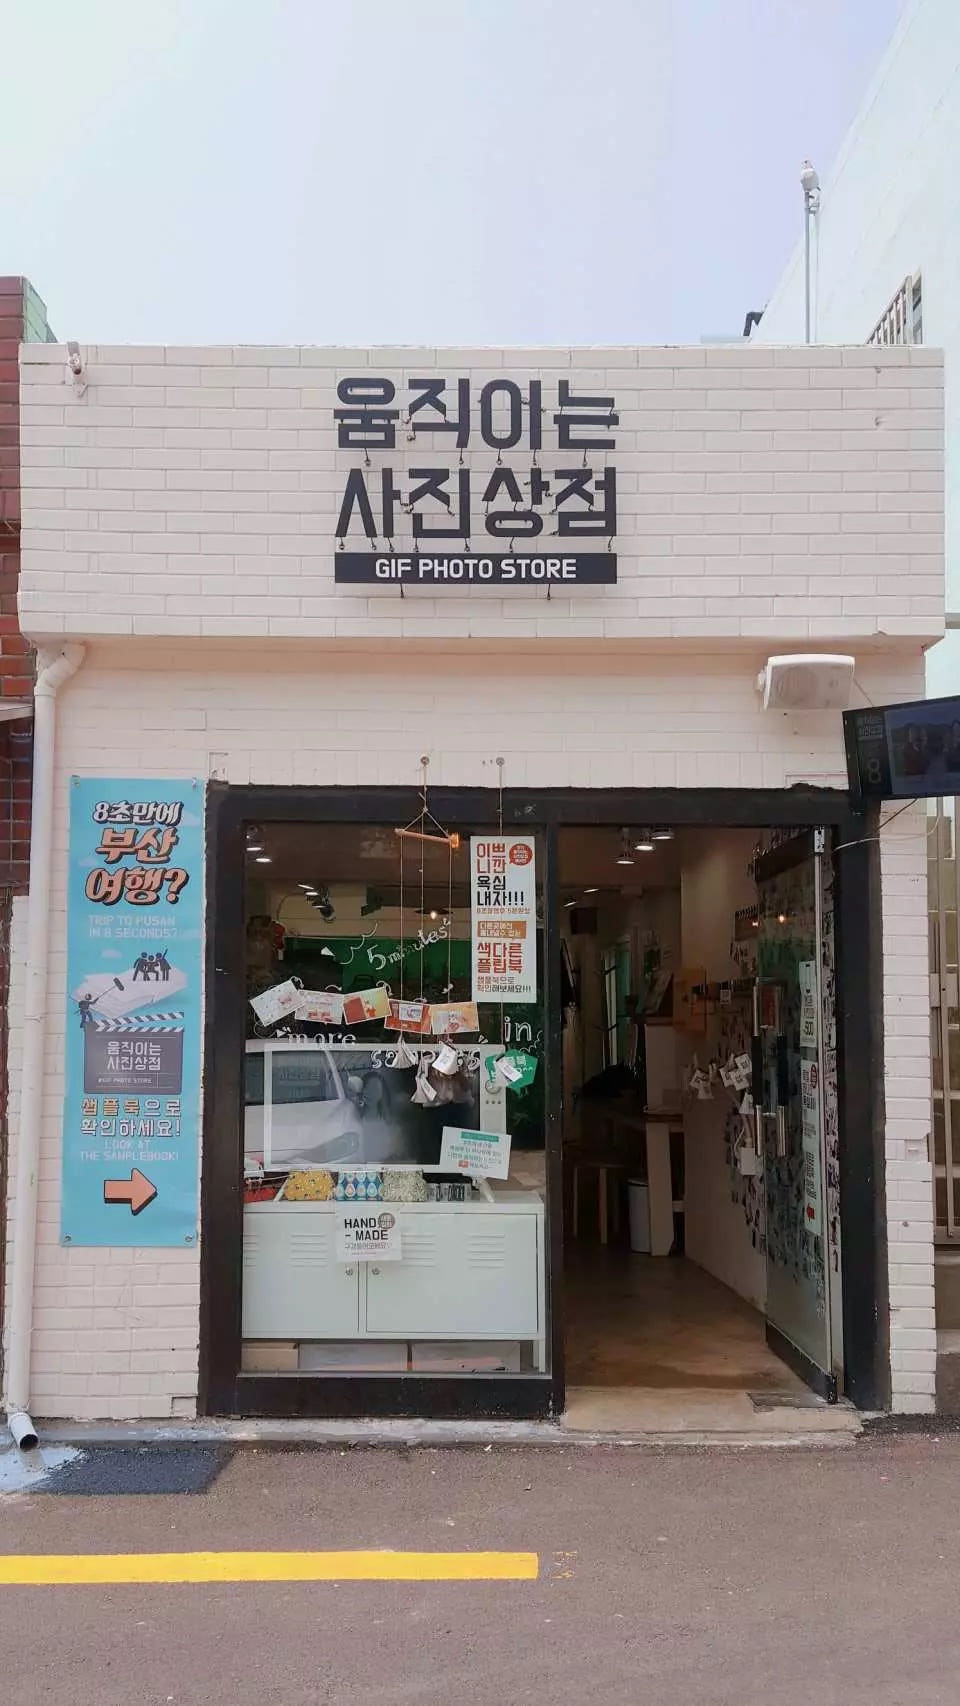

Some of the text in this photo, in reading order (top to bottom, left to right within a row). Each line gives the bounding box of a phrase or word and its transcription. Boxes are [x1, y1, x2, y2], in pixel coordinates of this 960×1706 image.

[333, 377, 619, 449] 움직이는
[335, 467, 617, 538] 사진상점
[375, 559, 577, 578] GIF PHOTO STORE
[93, 800, 184, 826] 8초만에
[95, 826, 180, 864] 부산
[476, 843, 506, 858] 이쁘
[476, 859, 507, 874] 니깐
[85, 866, 190, 906] 여행?
[477, 875, 506, 890] 욕심
[477, 891, 524, 906] 내자!!!
[88, 914, 113, 926] TRIP
[119, 914, 133, 926] TO
[89, 928, 101, 938] IN
[115, 928, 178, 939] SECONDS?
[366, 944, 386, 971] 5
[477, 943, 523, 957] 색다른
[477, 958, 523, 974] 플립북
[503, 1015, 533, 1043] in
[107, 1041, 163, 1056] 움직이는
[286, 1032, 357, 1050] more
[106, 1056, 161, 1071] 사진상점
[80, 1118, 181, 1137] 확인하세요!
[104, 1139, 151, 1150] LOOK AT
[80, 1151, 101, 1161] THE
[344, 1217, 377, 1229] HAND
[355, 1229, 389, 1241] MADE
